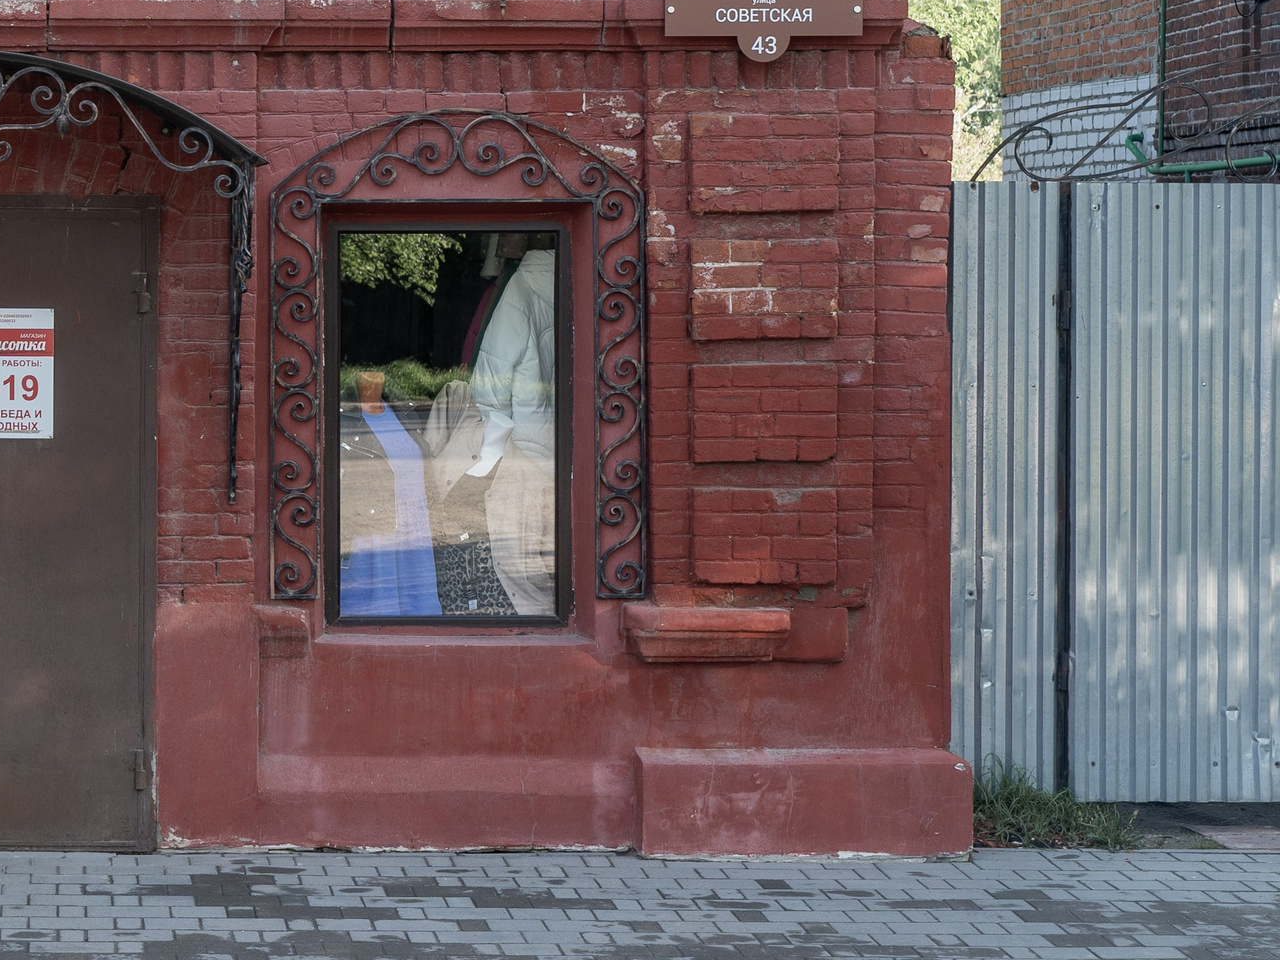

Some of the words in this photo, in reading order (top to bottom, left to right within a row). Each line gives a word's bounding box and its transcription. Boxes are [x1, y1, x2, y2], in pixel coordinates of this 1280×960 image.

[715, 8, 813, 23] СОВЕТСКАЯ
[751, 36, 777, 54] 43
[34, 410, 42, 418] И
